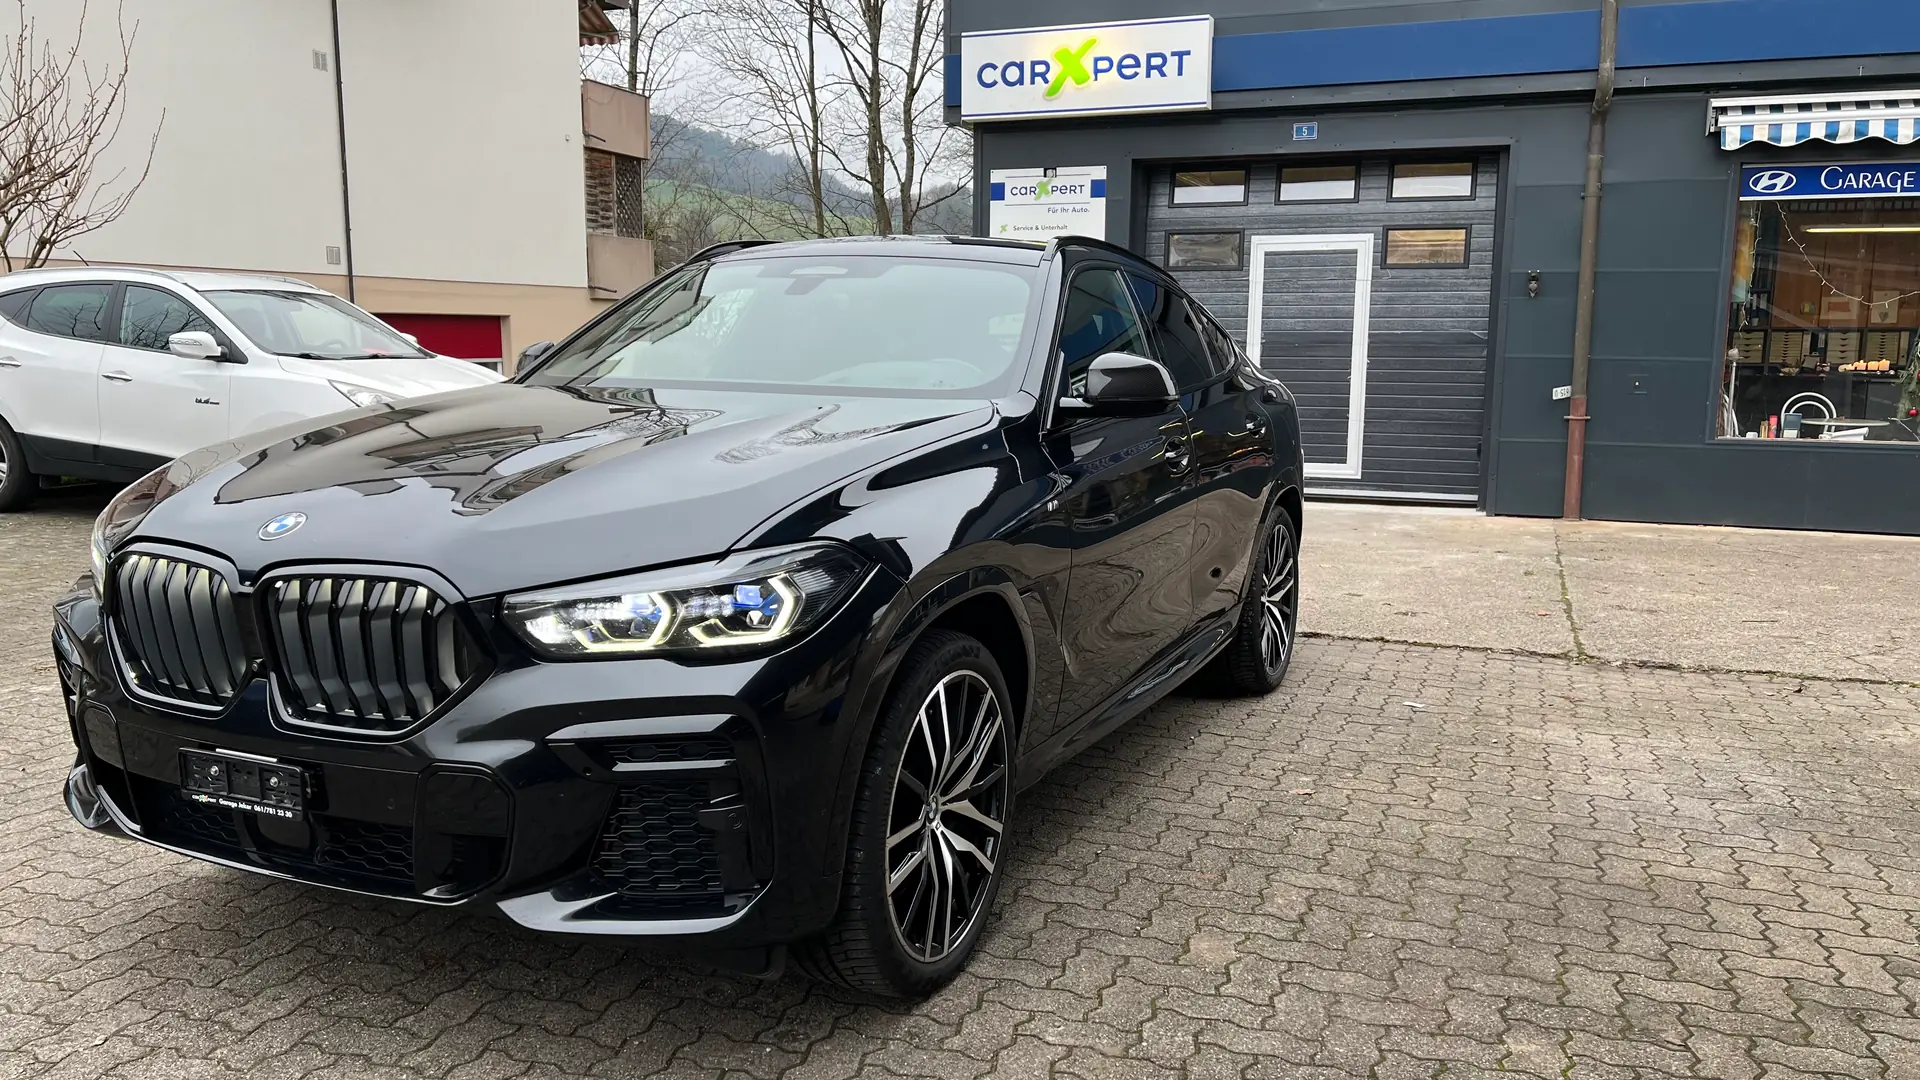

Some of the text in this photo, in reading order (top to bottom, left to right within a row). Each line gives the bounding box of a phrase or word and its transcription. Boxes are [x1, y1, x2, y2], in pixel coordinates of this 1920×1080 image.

[1302, 126, 1308, 136] 5
[1047, 206, 1090, 214] Für Ihr Auto.
[1034, 223, 1040, 231] &
[1040, 223, 1068, 231] Unterhalt
[219, 798, 238, 808] Garage
